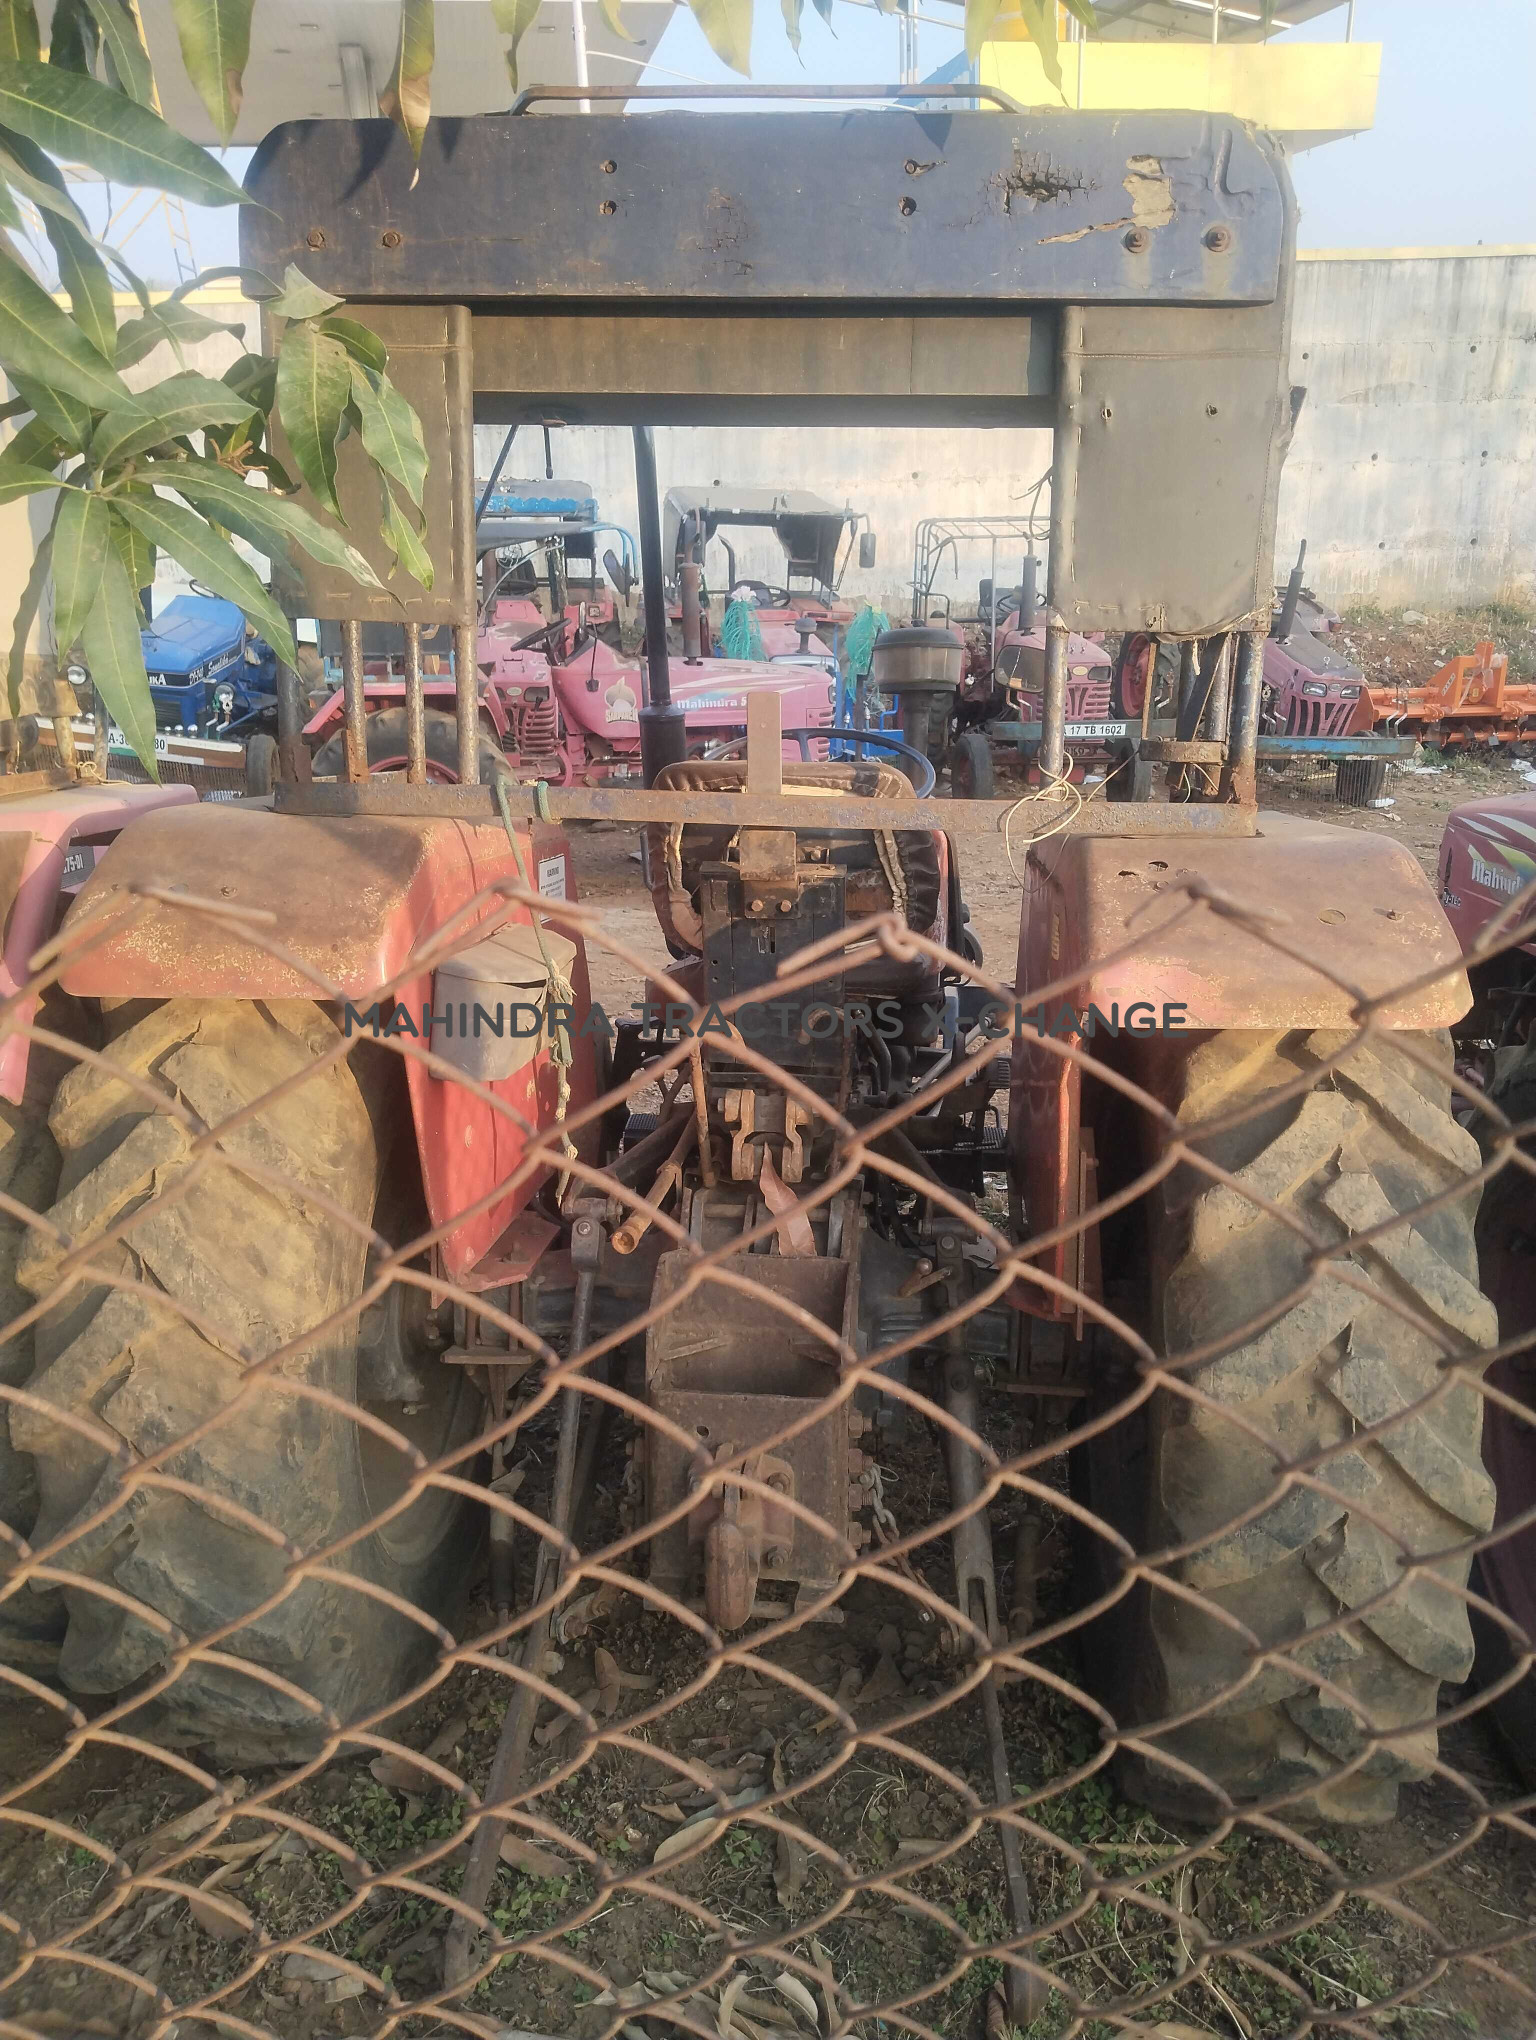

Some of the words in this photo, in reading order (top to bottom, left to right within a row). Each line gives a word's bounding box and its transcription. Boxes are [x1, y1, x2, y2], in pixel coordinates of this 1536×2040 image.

[676, 699, 738, 709] Mahindra
[1071, 726, 1081, 735] 17
[1084, 726, 1097, 735] TB
[1100, 725, 1122, 735] 1602
[63, 853, 84, 874] 75-DI
